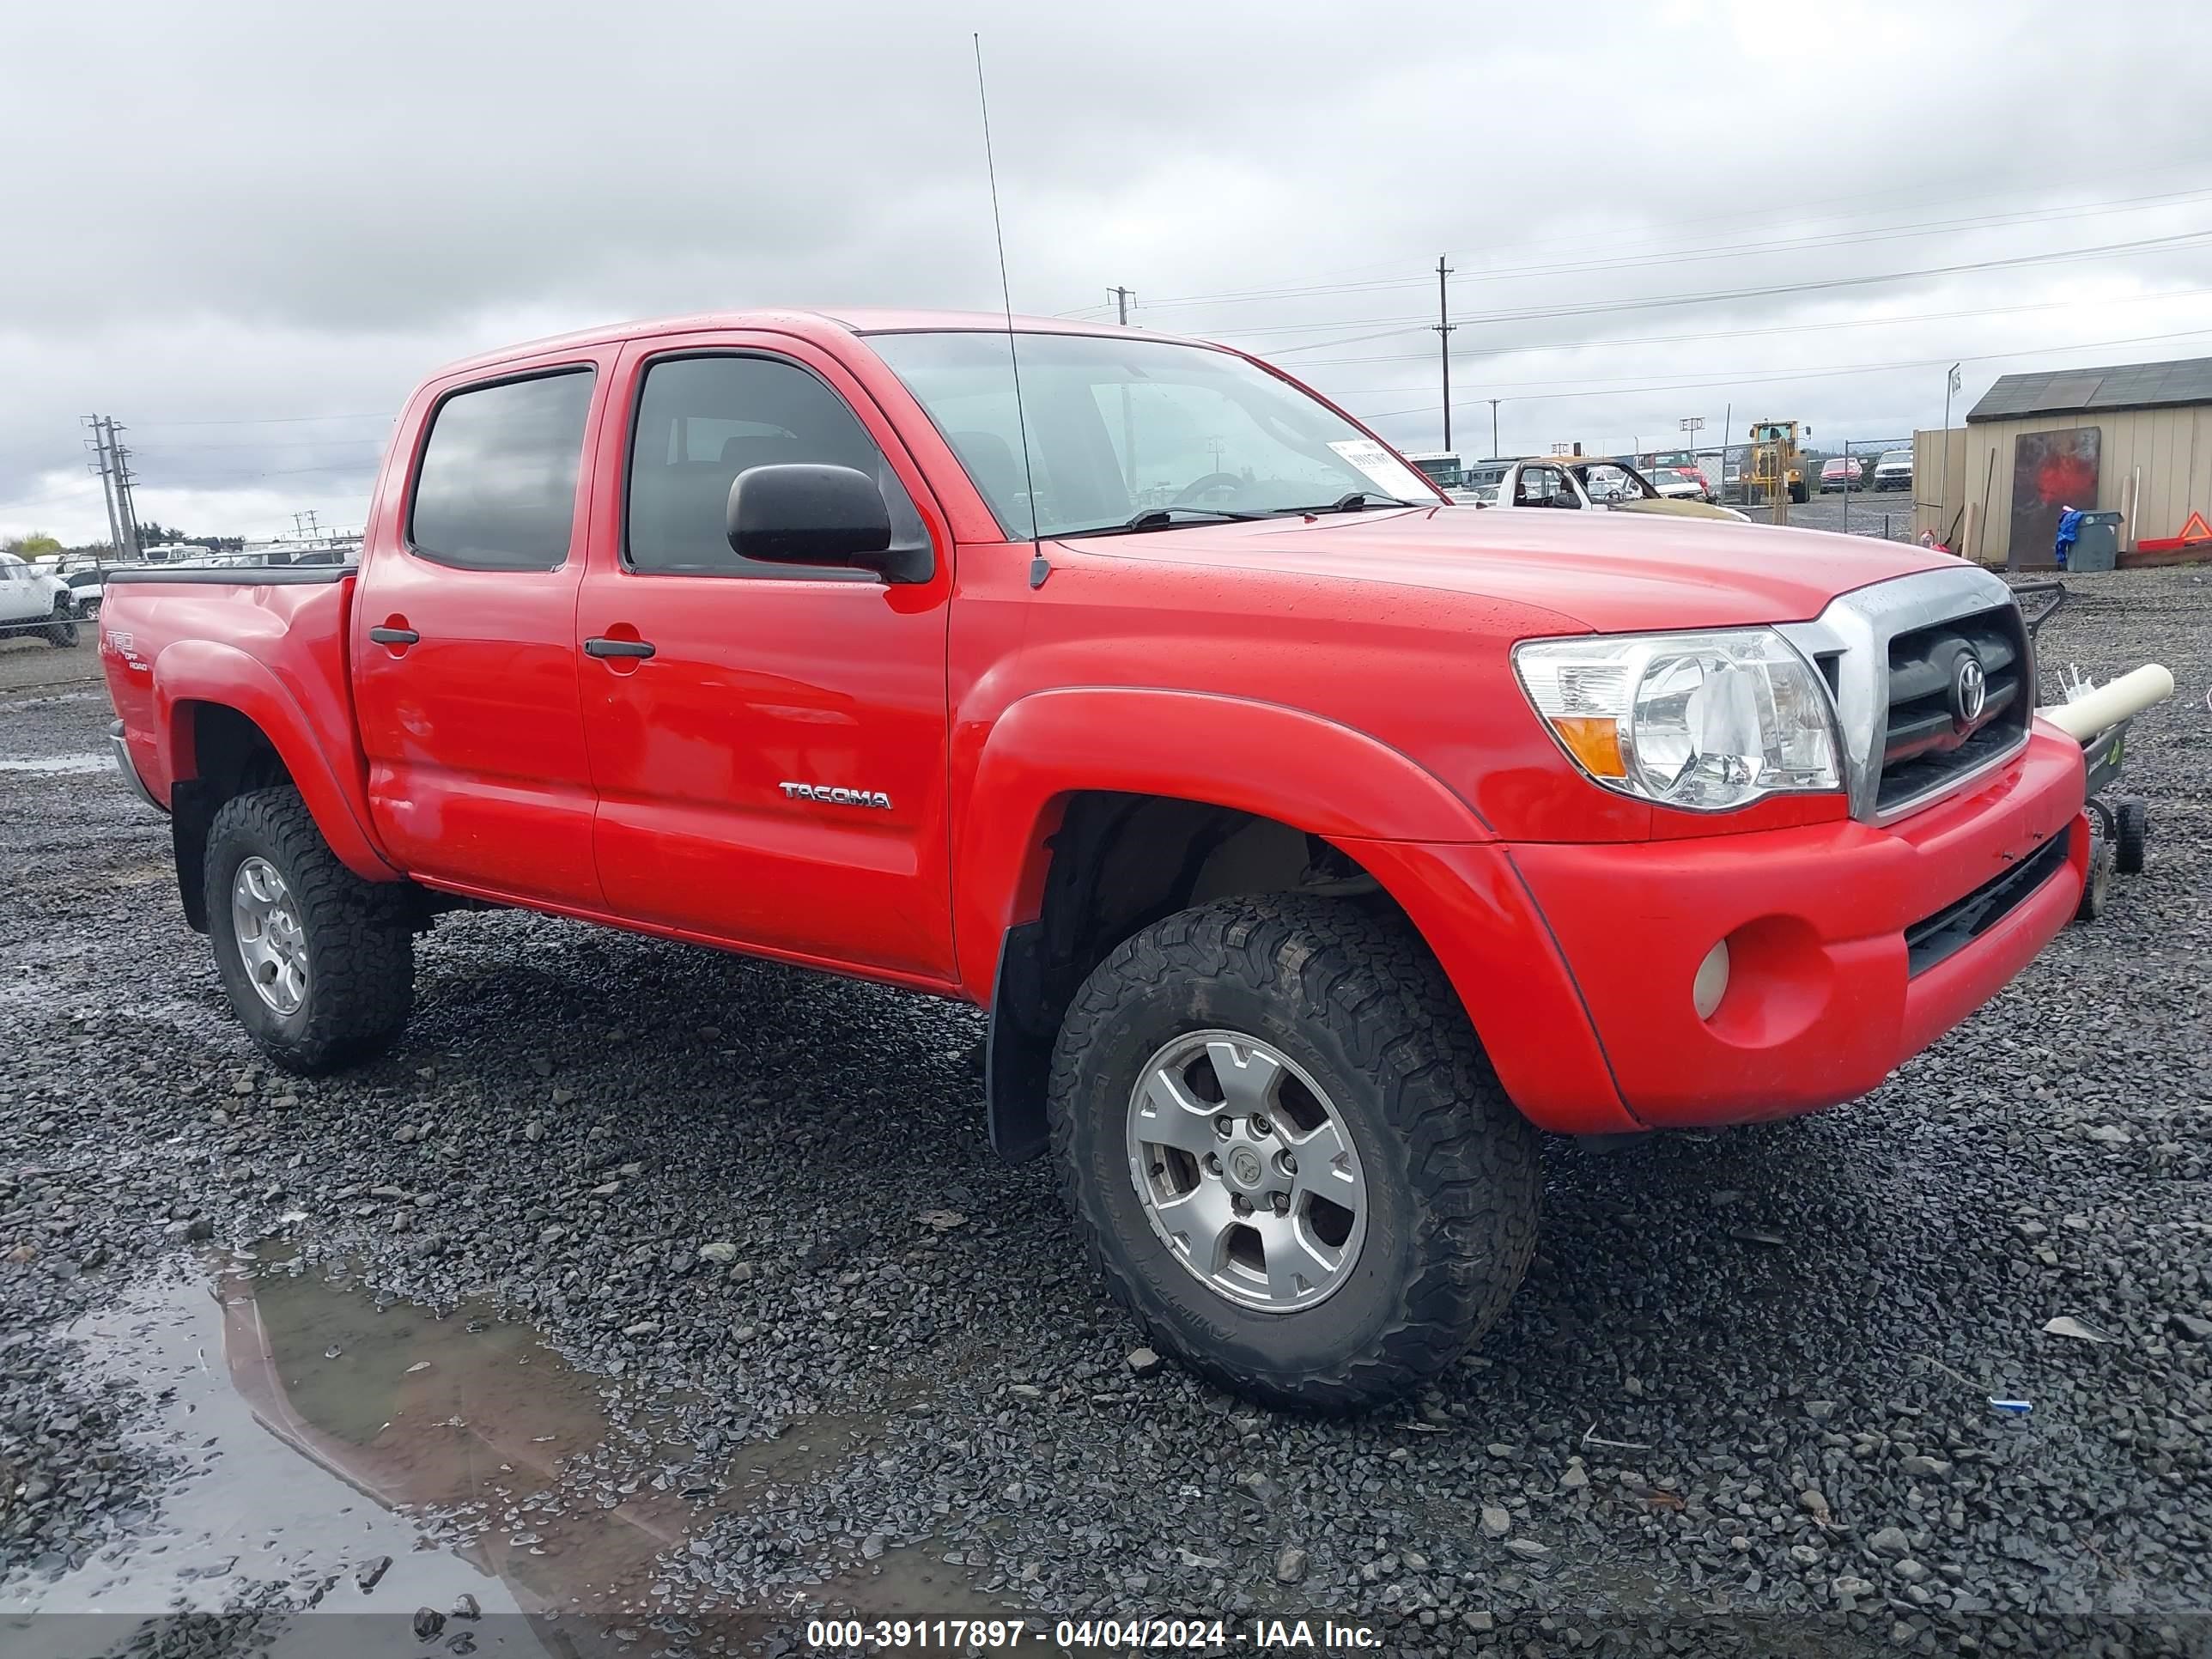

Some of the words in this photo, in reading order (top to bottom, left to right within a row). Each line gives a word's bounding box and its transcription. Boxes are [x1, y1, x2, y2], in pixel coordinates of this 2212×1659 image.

[106, 630, 133, 654] TRD
[129, 662, 148, 671] ROAD
[779, 781, 893, 810] TACOMA
